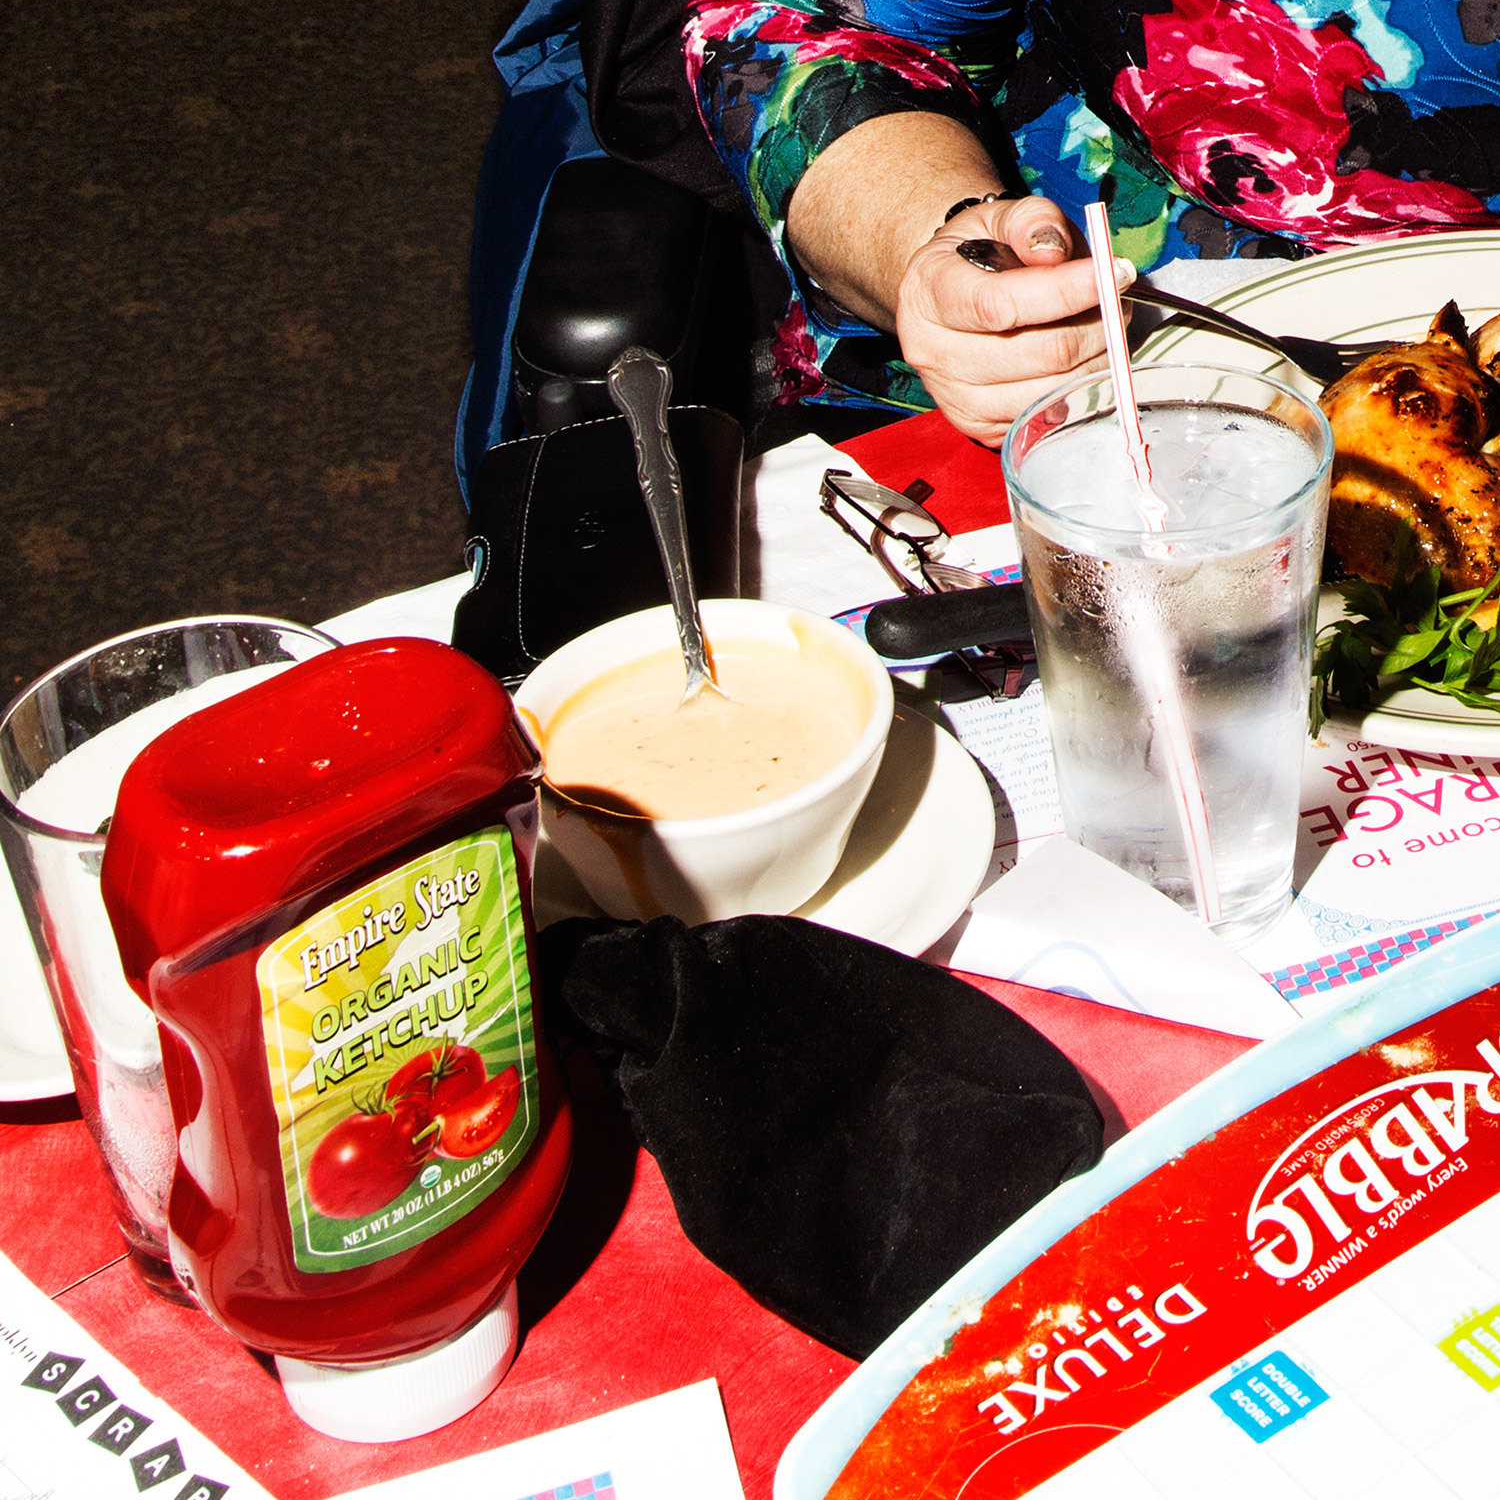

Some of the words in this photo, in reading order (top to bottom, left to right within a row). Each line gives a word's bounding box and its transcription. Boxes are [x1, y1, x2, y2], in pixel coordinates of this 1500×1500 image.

[1352, 849, 1392, 868] to
[300, 901, 406, 991] Empire
[414, 866, 480, 930] State
[311, 925, 483, 1043] ORGANIC
[313, 970, 489, 1094] KETCHUP
[1316, 1098, 1386, 1152] CROSSWORD
[1281, 1149, 1316, 1178] GAME
[1427, 1156, 1468, 1192] Every
[342, 1227, 368, 1249] NET
[369, 1213, 390, 1235] WT
[392, 1207, 404, 1225] 20
[405, 1196, 424, 1216] OZ
[435, 1181, 452, 1200] LB
[453, 1174, 461, 1188] 4
[461, 1162, 482, 1184] OZ)
[482, 1148, 505, 1171] 567g
[1378, 1189, 1427, 1230] word's
[1366, 1225, 1378, 1239] a
[1297, 1235, 1368, 1291] WINNER.
[976, 1283, 1207, 1435] DELUXE
[1247, 1377, 1290, 1417] LETTER
[1262, 1363, 1311, 1408] DOUBLE
[1230, 1389, 1272, 1429] SCORE
